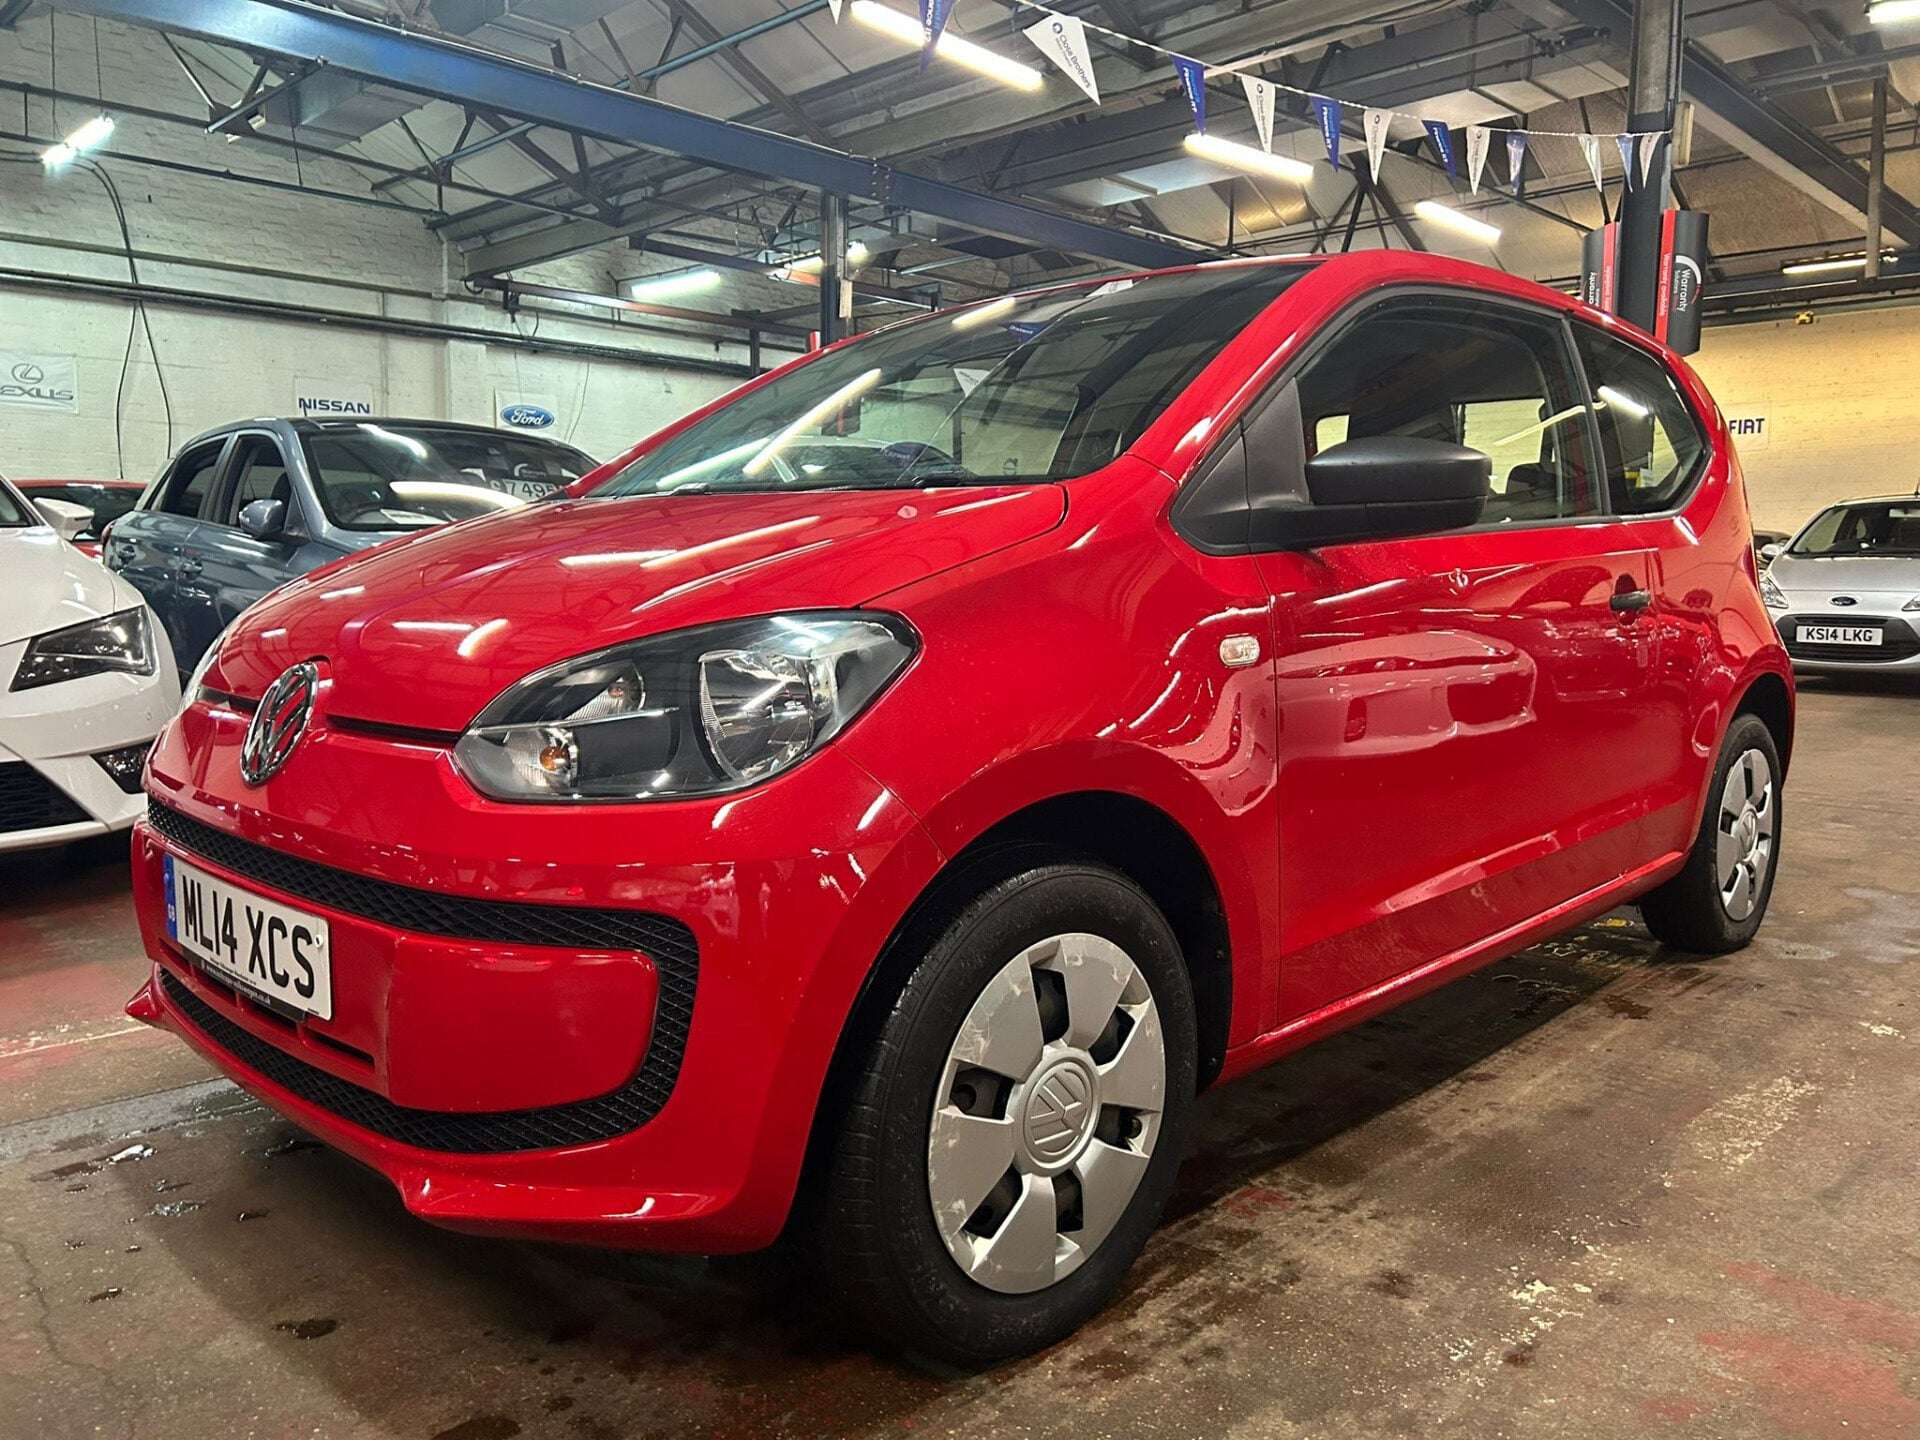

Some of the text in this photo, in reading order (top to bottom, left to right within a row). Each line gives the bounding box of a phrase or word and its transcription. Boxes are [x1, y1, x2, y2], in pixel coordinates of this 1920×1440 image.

[1059, 34, 1091, 88] Close Brothers
[1588, 271, 1598, 304] arranty
[1677, 269, 1691, 312] Warranty
[0, 385, 74, 400] EXUS
[298, 398, 370, 414] NISSAN
[511, 408, 545, 425] Ford
[1729, 418, 1765, 434] FIAT
[1806, 627, 1873, 642] KS14 LKG
[182, 874, 238, 964] ML14
[245, 904, 315, 999] XCS
